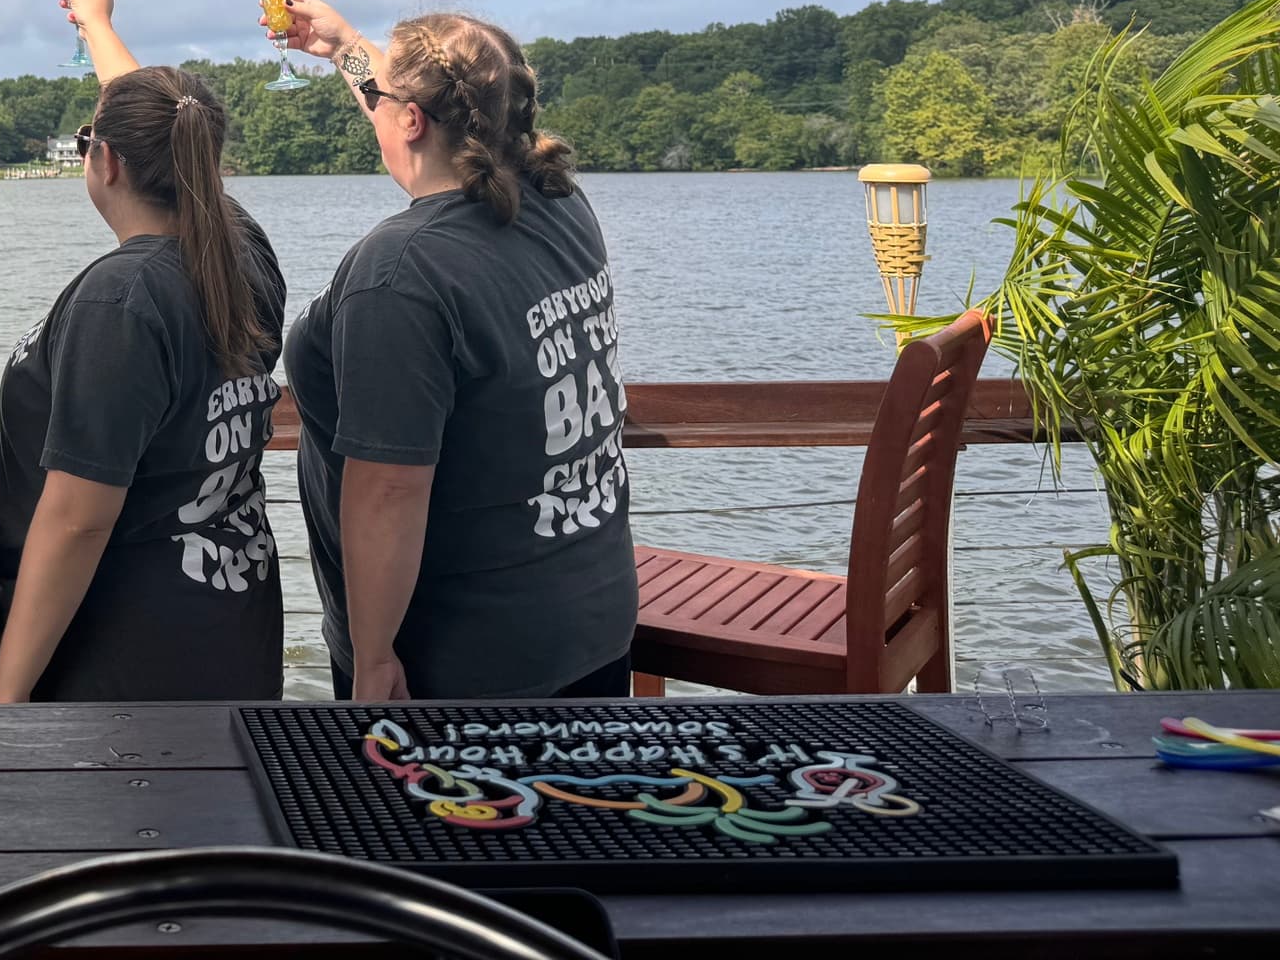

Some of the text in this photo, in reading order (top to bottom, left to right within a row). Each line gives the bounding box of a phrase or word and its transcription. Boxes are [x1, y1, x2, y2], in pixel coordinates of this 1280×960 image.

[537, 324, 576, 378] ON
[205, 411, 252, 464] ON
[399, 744, 527, 765] Hour
[539, 741, 706, 765] Happy
